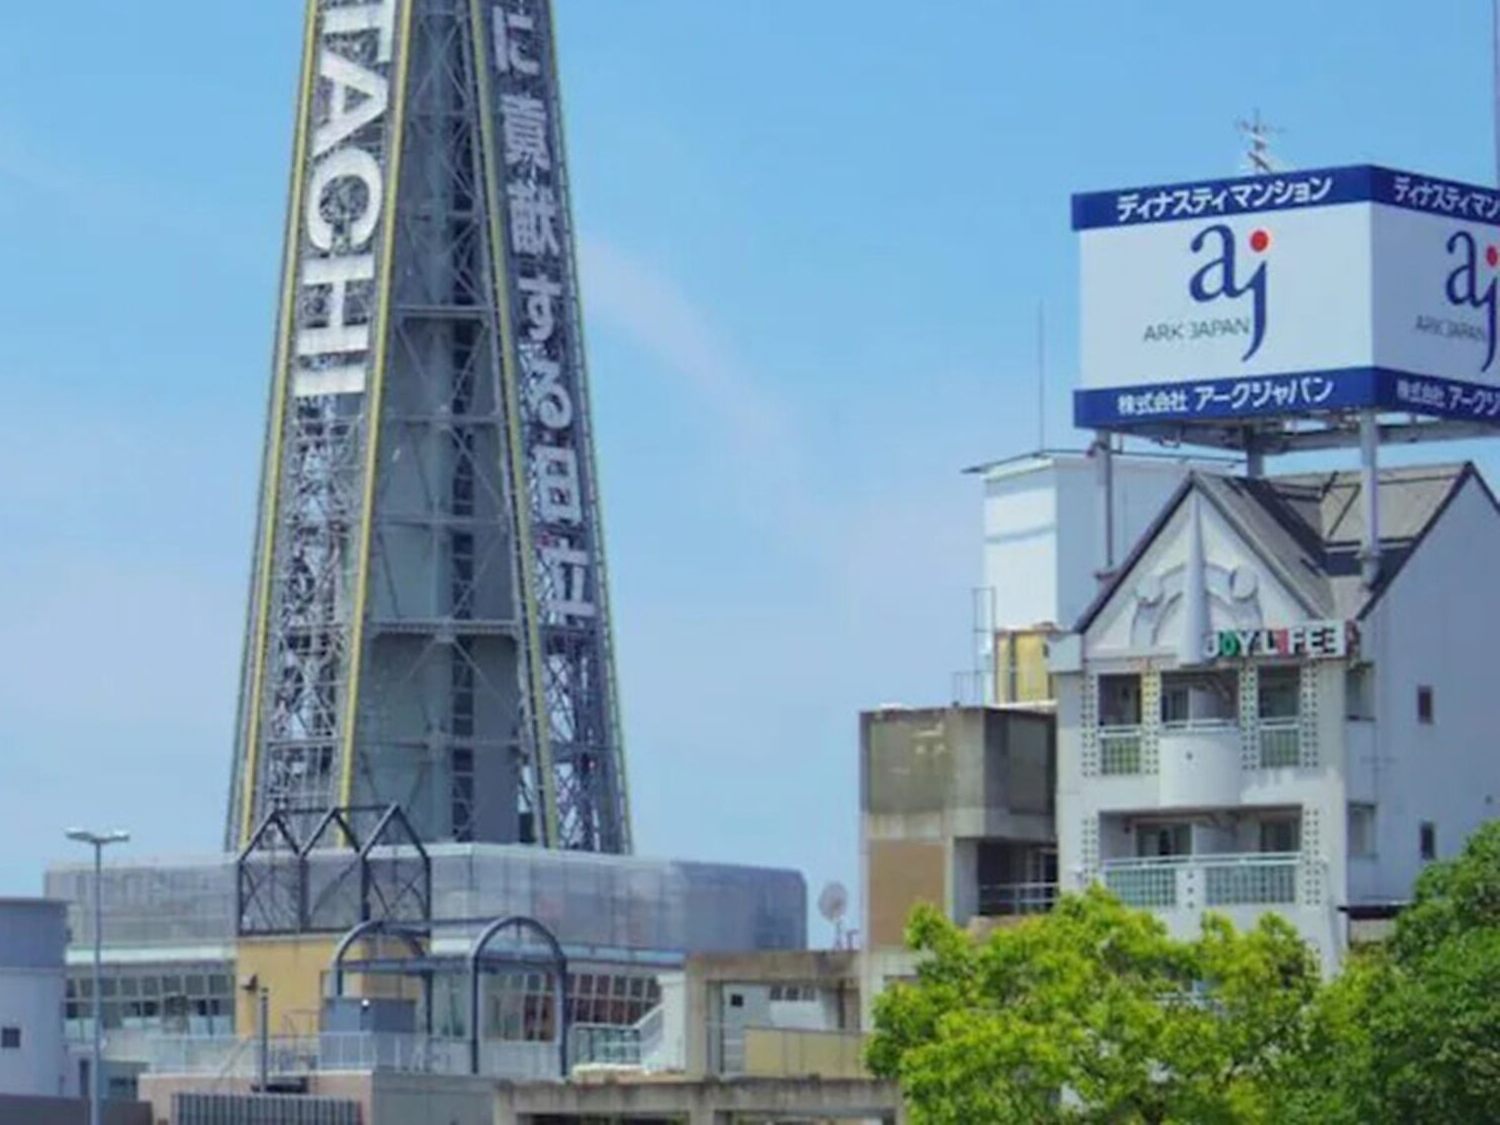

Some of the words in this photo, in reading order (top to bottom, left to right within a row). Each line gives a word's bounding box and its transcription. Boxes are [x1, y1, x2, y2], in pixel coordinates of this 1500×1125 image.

[1117, 177, 1332, 222] ディナスティマンション
[1143, 324, 1184, 342] ARK
[1189, 317, 1250, 340] JAPAN
[1117, 391, 1188, 415] 株式会社
[1194, 378, 1333, 411] アークジャパン
